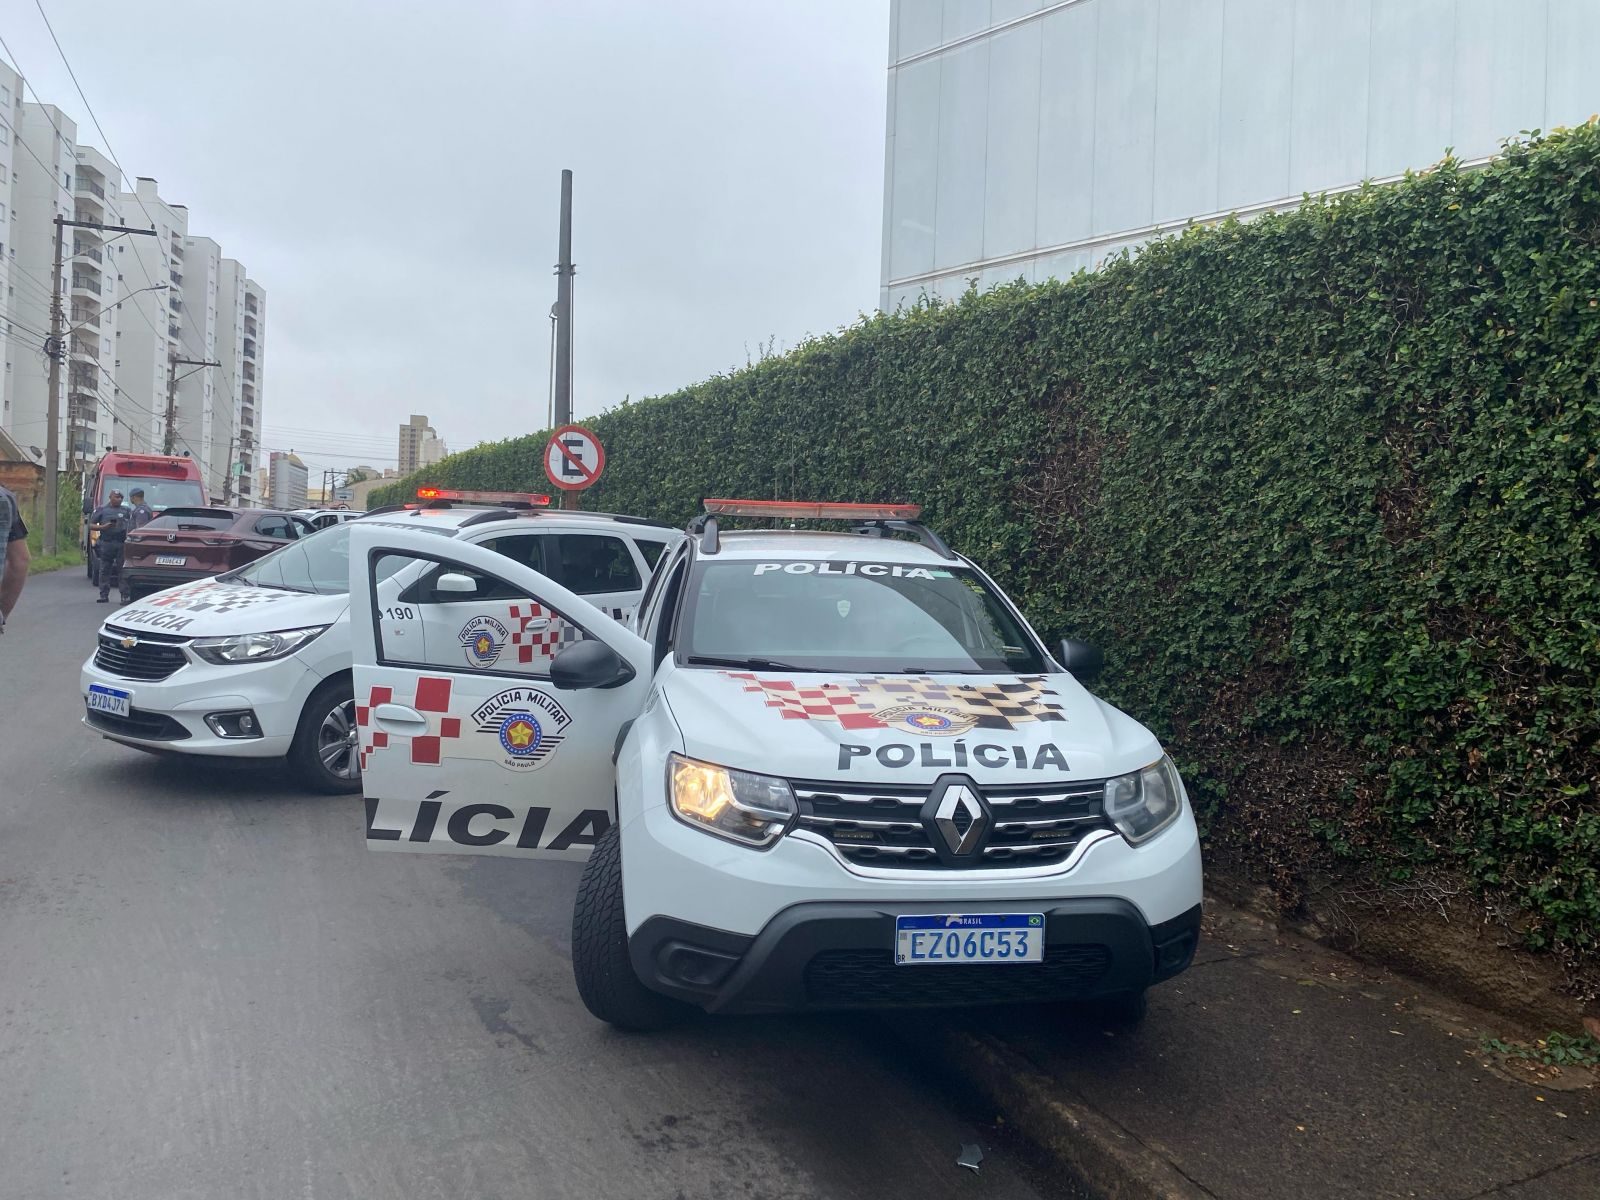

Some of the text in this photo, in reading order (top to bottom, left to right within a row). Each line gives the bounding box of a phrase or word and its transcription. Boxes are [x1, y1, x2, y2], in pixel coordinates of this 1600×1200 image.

[753, 562, 936, 580] POLÍCIA
[113, 609, 194, 631] POLÍCIA
[386, 607, 414, 620] 190
[484, 618, 506, 637] MILITAR
[478, 691, 566, 725] POLÍCIA MILITAR
[838, 738, 1071, 772] POLÍCIA
[897, 954, 906, 963] BR
